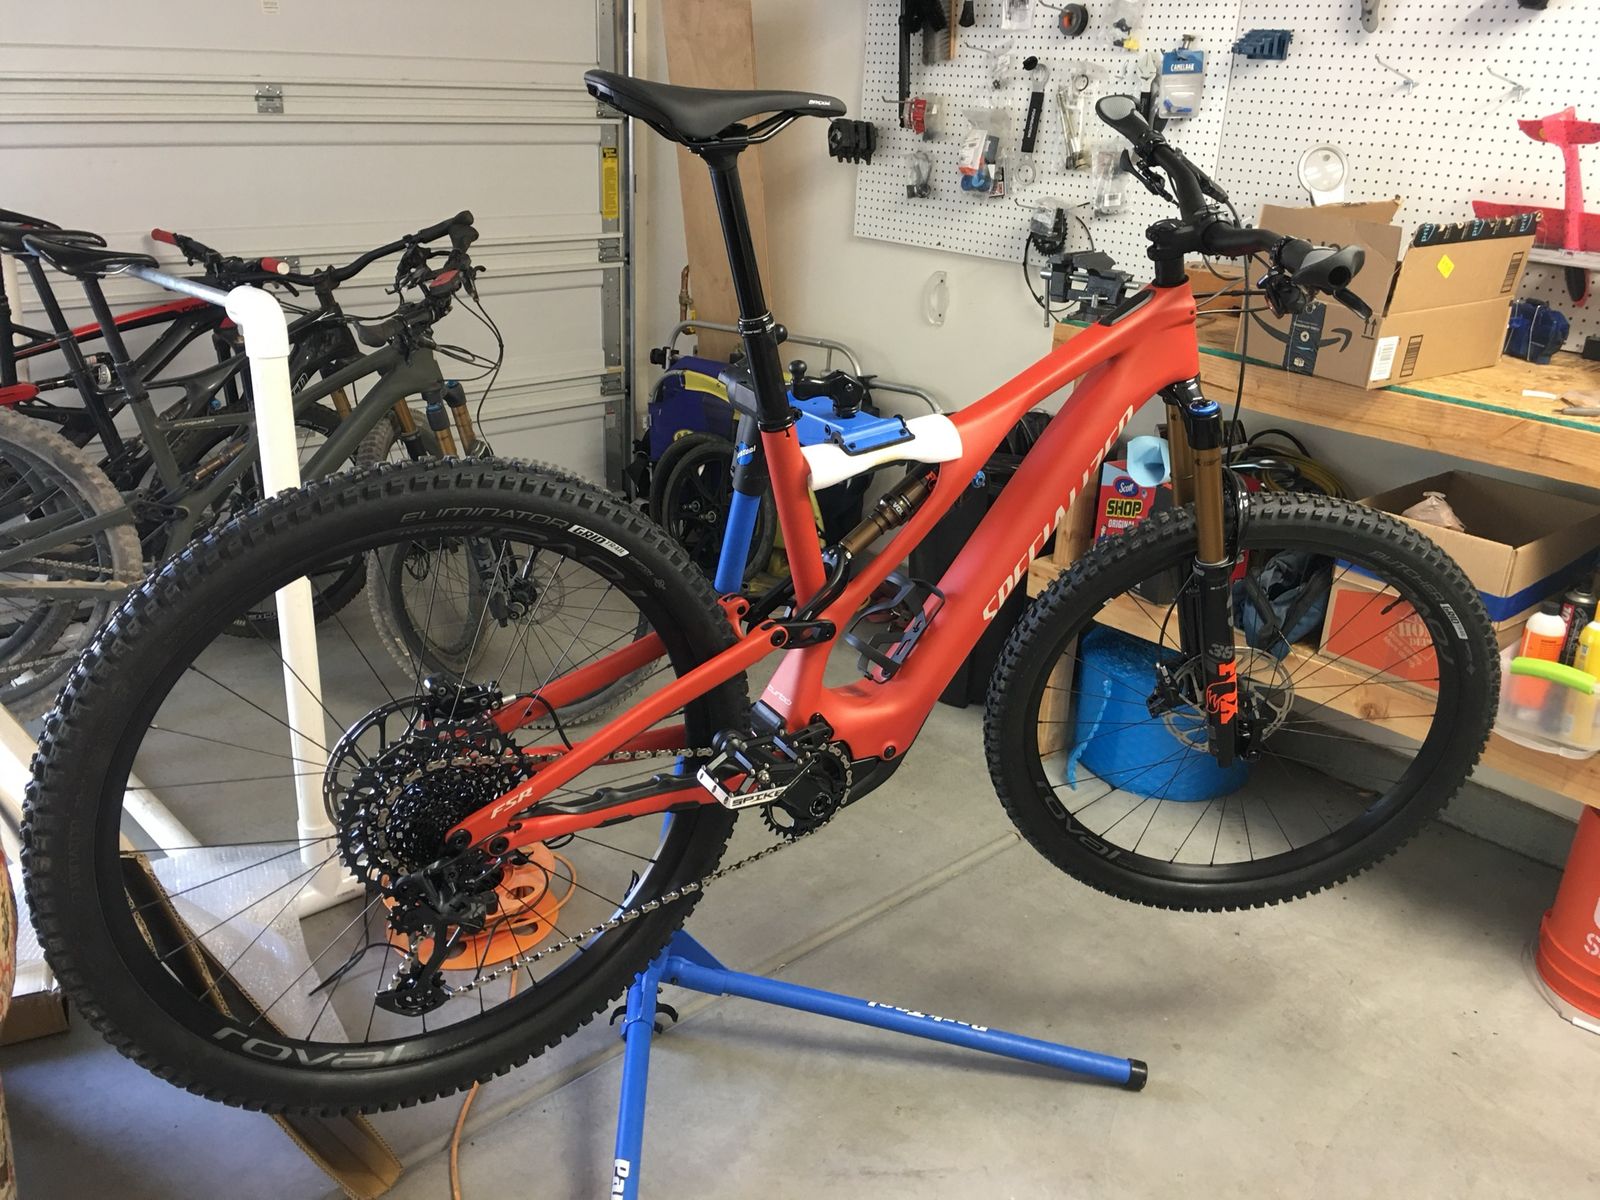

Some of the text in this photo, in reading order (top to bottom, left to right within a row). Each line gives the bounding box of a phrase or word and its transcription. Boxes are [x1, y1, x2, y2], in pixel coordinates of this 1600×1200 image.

[1171, 63, 1195, 72] CAMELBAK
[1118, 482, 1134, 493] Scott
[400, 507, 570, 529] ELIMINATOR
[1106, 498, 1143, 518] SHOP
[573, 527, 625, 554] GRID TRAIL
[1369, 550, 1445, 601] BUTCHER
[491, 786, 534, 820] FSR
[732, 789, 785, 806] SPIKE
[1035, 781, 1121, 860] roval
[212, 1027, 405, 1068] roval
